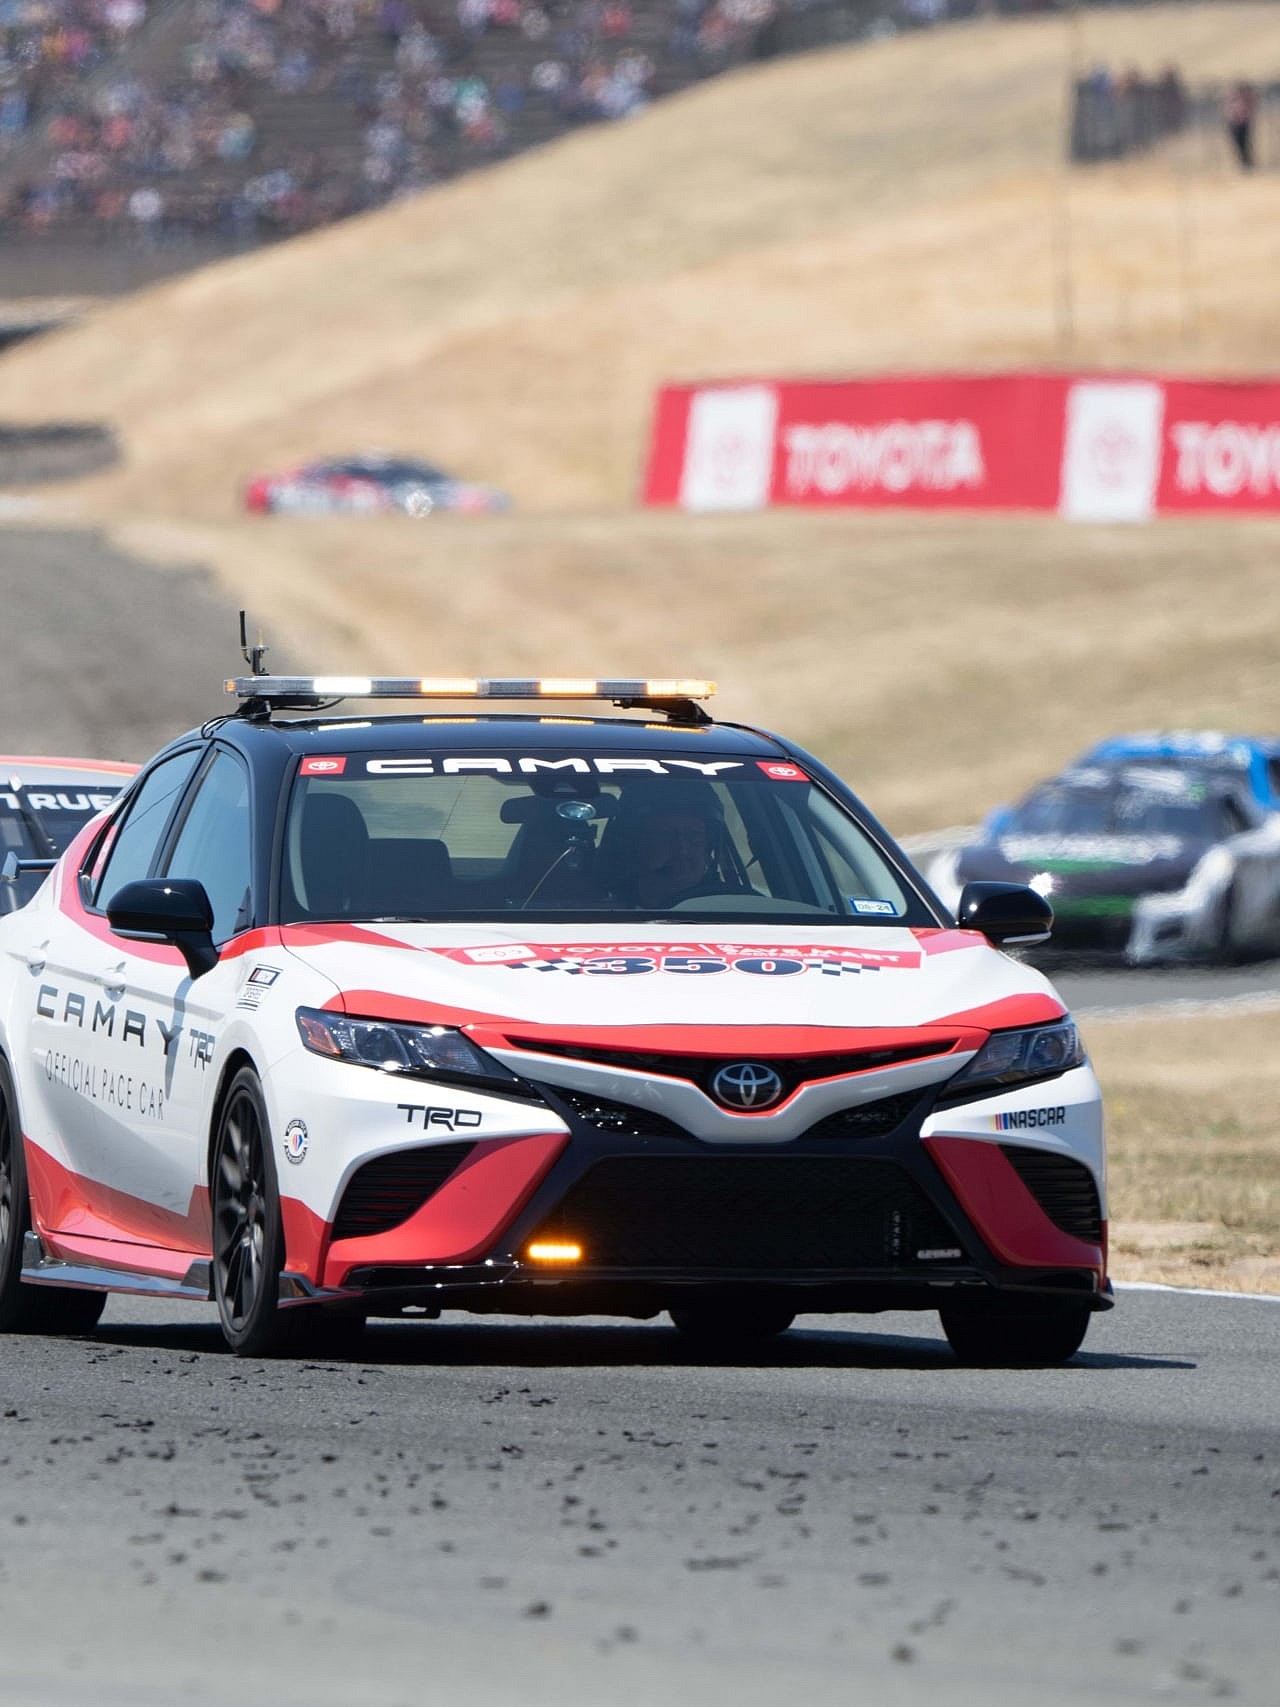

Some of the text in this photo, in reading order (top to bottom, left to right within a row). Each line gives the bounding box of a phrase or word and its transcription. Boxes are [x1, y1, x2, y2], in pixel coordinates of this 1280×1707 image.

[784, 420, 984, 493] TOYOTA
[1172, 422, 1280, 496] TOY
[366, 757, 744, 776] CAMRY
[542, 945, 697, 954] TOYOTA
[582, 956, 806, 976] 350
[36, 984, 184, 1056] CAMRY
[46, 1050, 165, 1121] OFFICIAL PACE CAR
[397, 1103, 483, 1132] TRD
[1009, 1106, 1066, 1130] NASCAR
